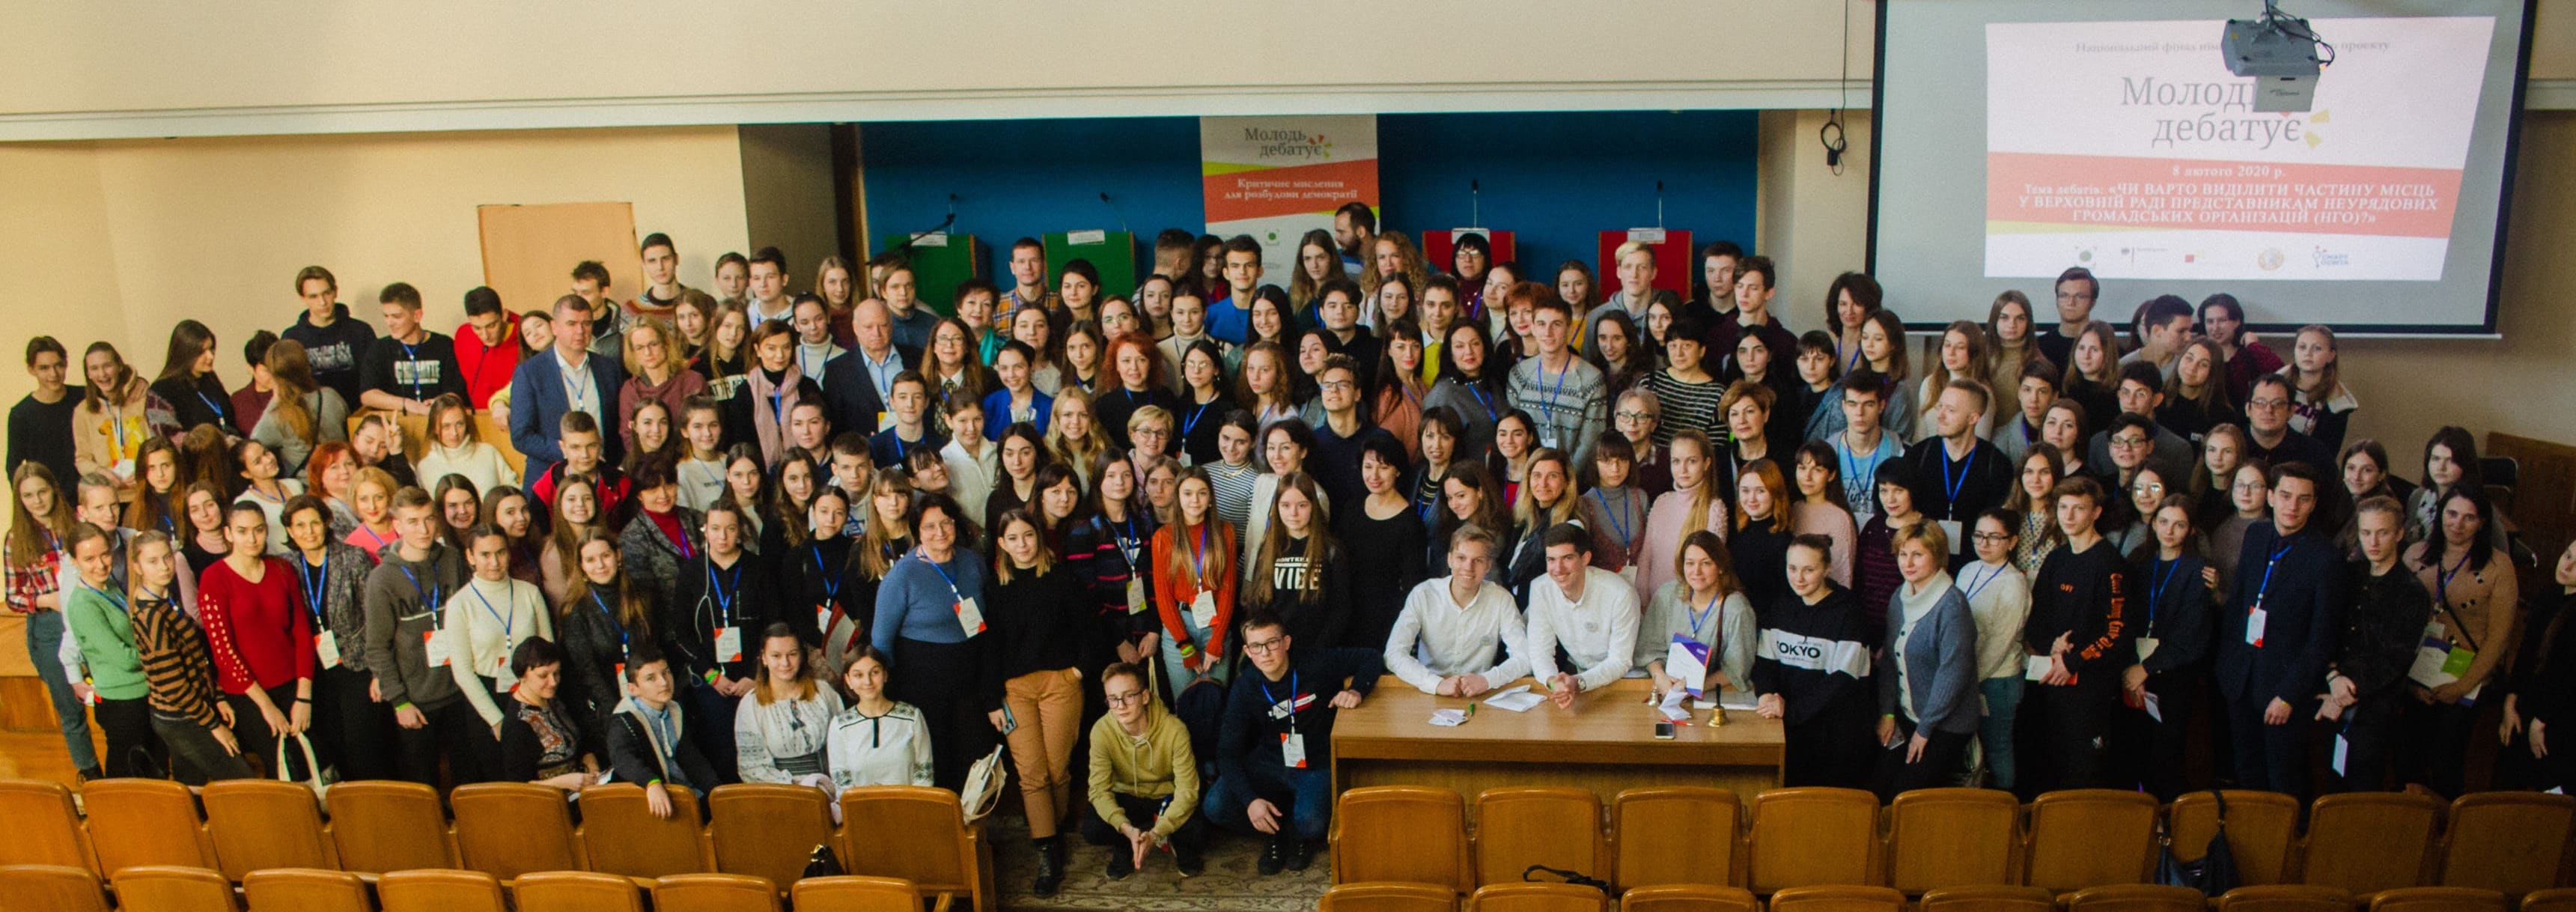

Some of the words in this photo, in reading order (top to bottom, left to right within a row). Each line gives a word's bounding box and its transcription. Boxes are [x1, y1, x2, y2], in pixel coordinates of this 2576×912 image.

[2121, 76, 2254, 113] Молод
[1245, 127, 1306, 143] Молодь
[2151, 112, 2301, 150] дебатує
[1259, 142, 1322, 159] дебатує
[2172, 165, 2179, 177] 8
[2184, 168, 2232, 177] лютого
[2237, 165, 2270, 177] 2020
[2145, 183, 2197, 195] ВАРТО
[2202, 183, 2289, 197] ВИДІЛИТИ
[2294, 183, 2376, 197] ЧАСТИНУ
[2379, 185, 2435, 198] МІСЦЬ
[2018, 195, 2030, 207] У
[2034, 193, 2124, 208] ВЕРХОВНІЙ
[2130, 196, 2166, 210] РАДІ
[2171, 196, 2318, 210] ПРЕДСТАВНИКАМ
[2323, 198, 2439, 211] НЕУРЯДОВИХ
[2072, 210, 2193, 223] ГРОМАДСЬКИХ
[2199, 208, 2309, 225] ОРГАНІЗАЦІЙ
[1776, 640, 1821, 658] OKYO
